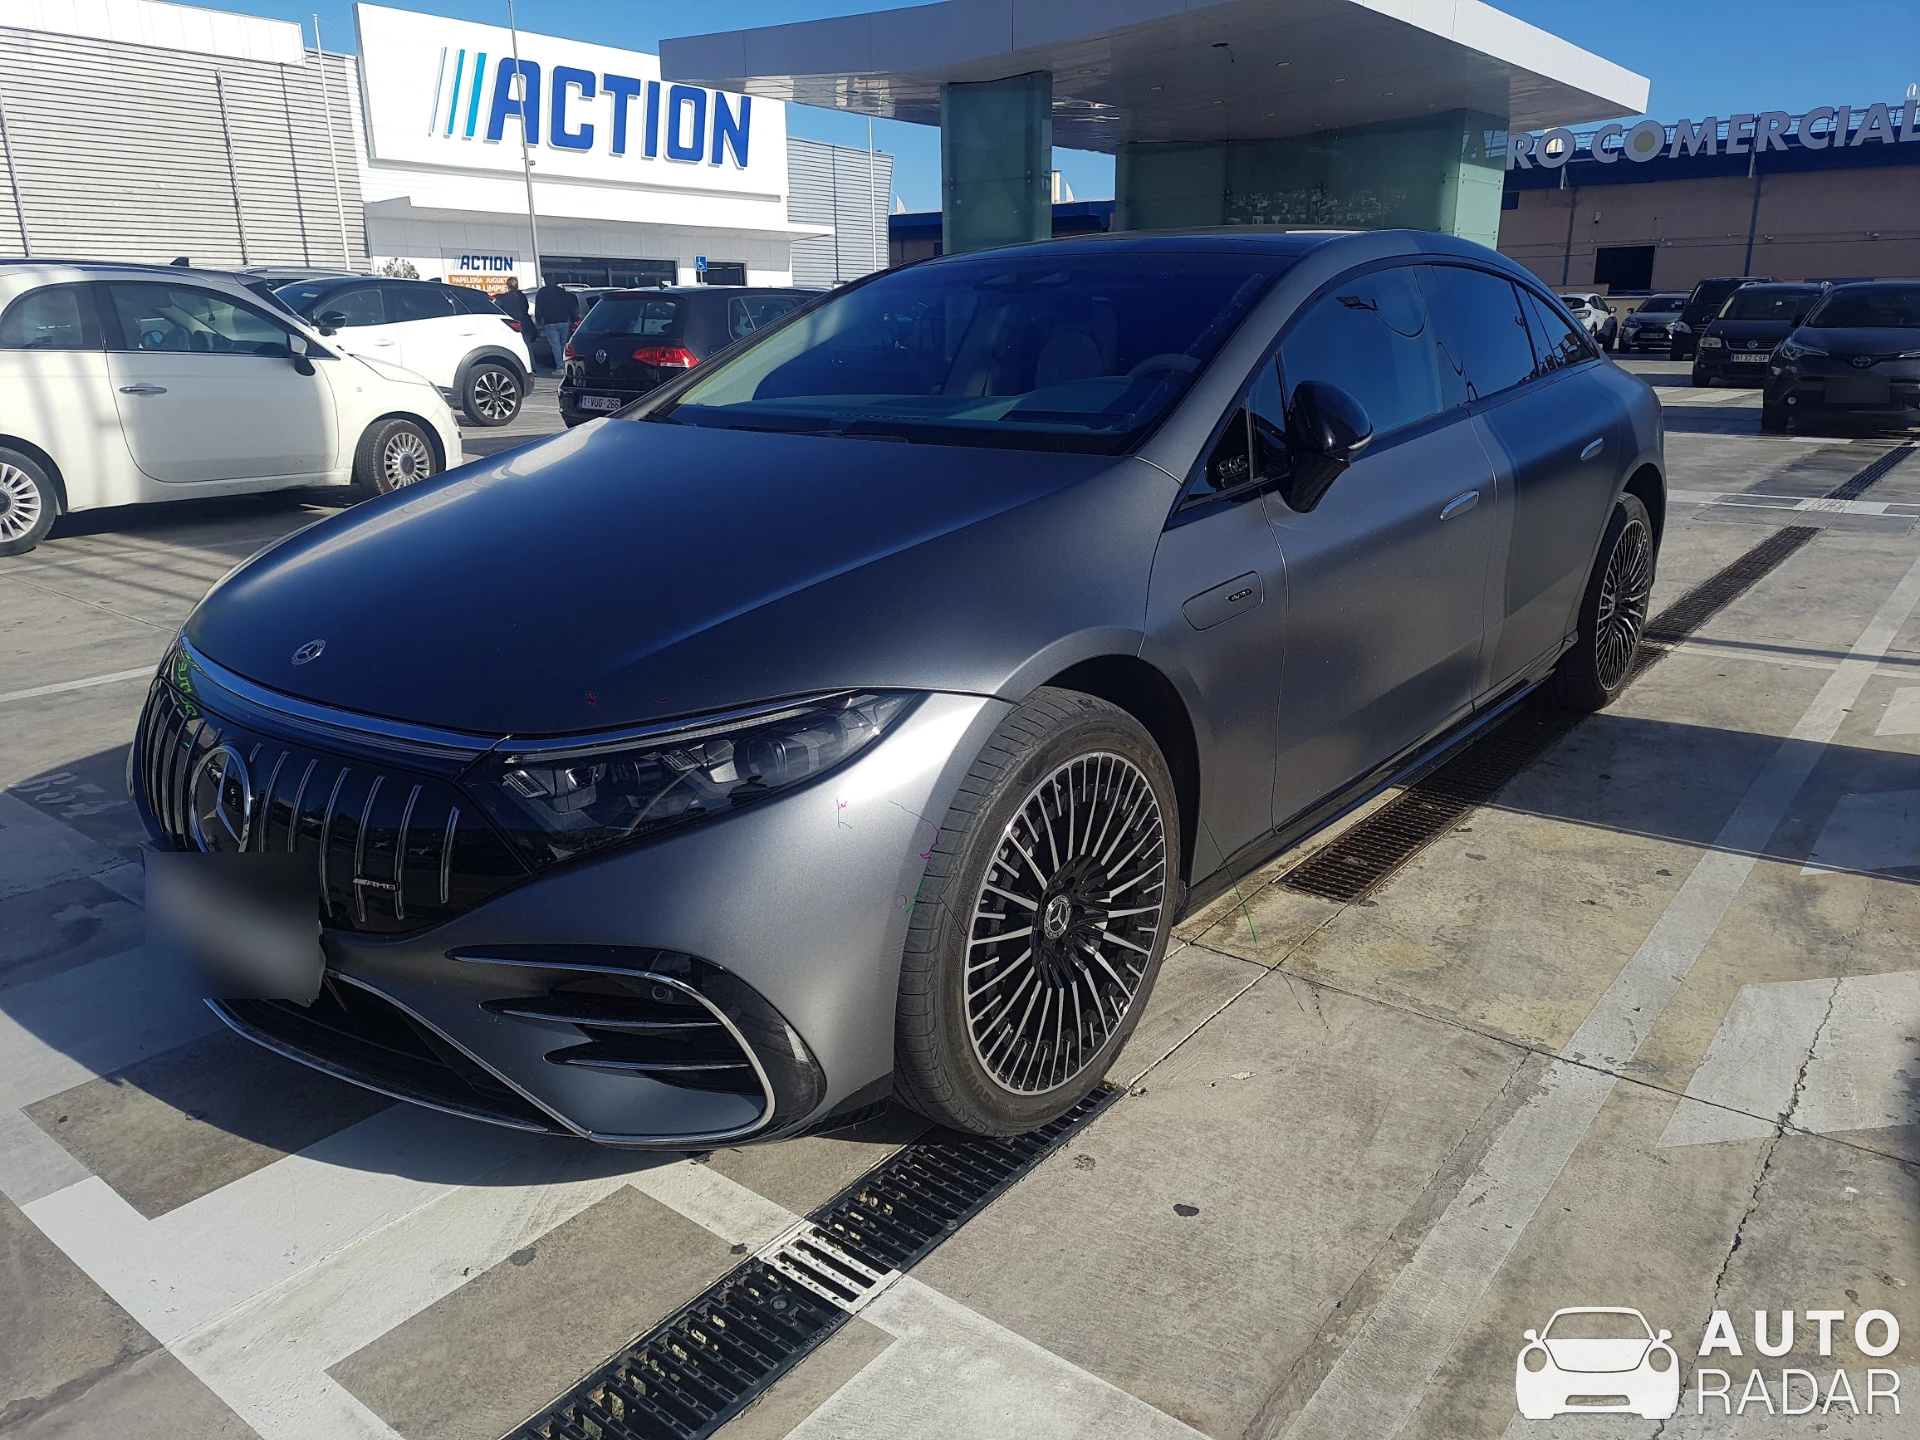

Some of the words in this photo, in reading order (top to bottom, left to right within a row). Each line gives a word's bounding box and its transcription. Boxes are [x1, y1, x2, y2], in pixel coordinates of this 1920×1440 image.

[485, 57, 752, 168] ACTION
[1591, 100, 1920, 163] COMERCIAL
[460, 255, 513, 271] ACTION
